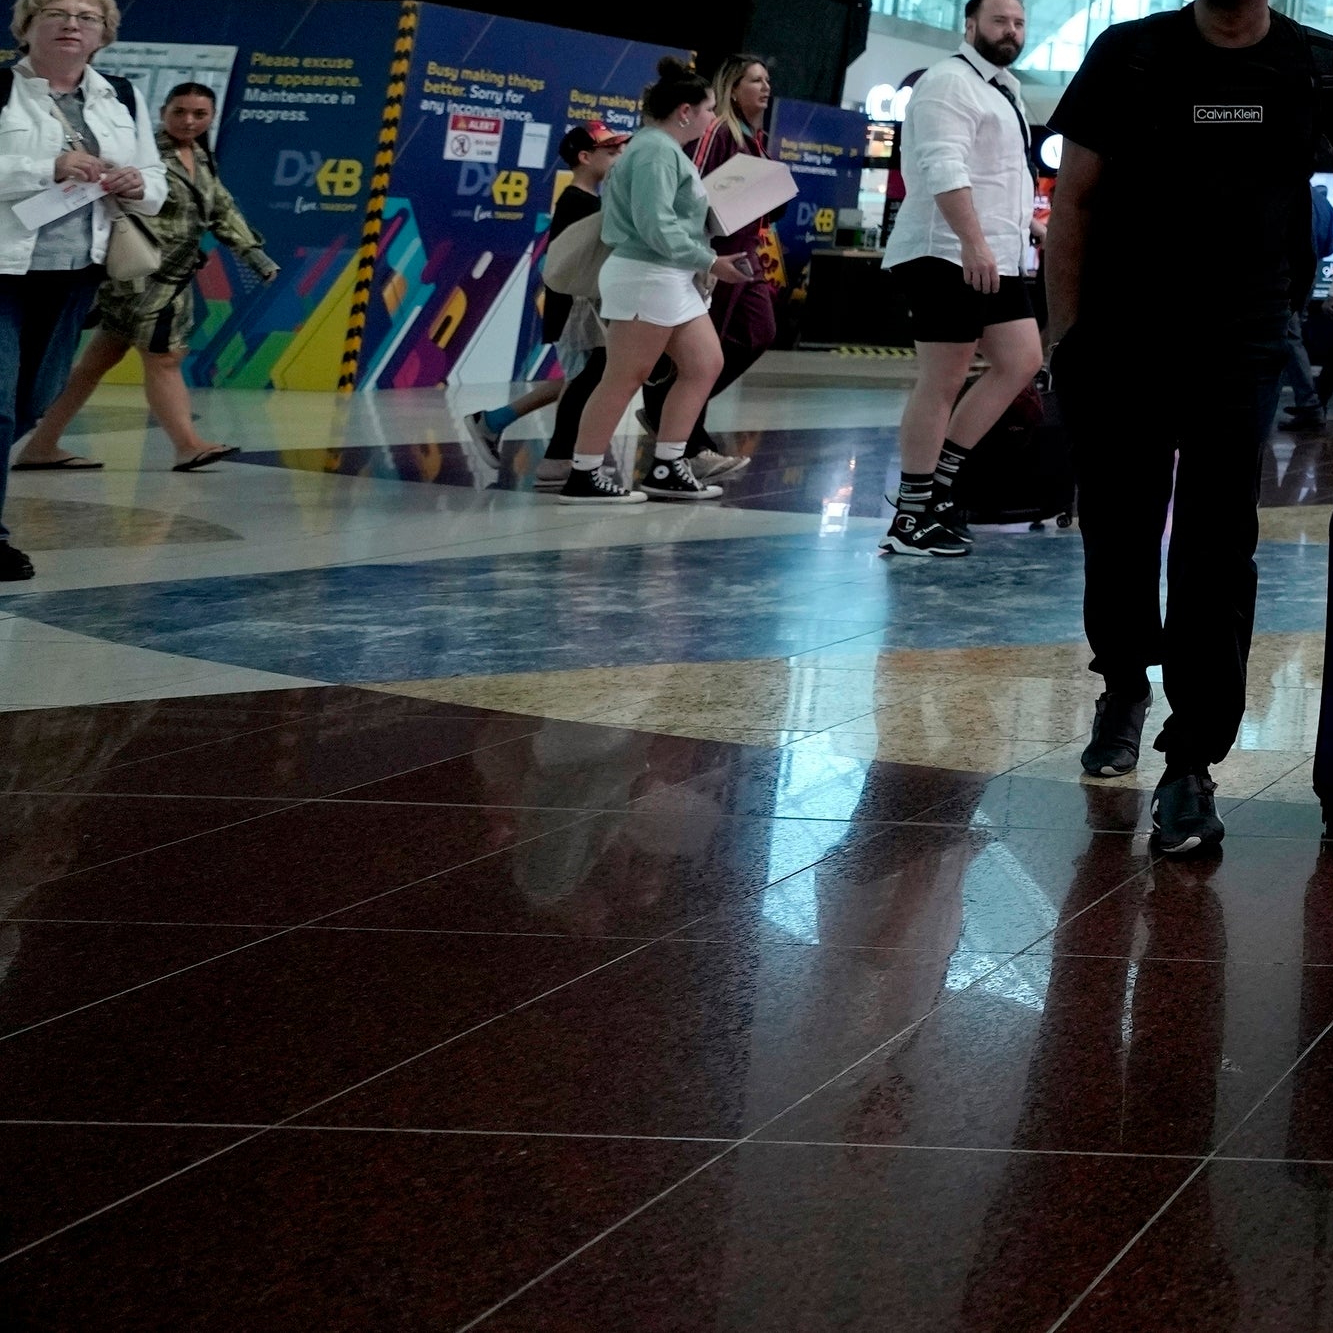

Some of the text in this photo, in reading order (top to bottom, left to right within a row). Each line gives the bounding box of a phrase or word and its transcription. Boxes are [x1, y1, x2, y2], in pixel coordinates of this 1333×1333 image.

[251, 52, 354, 69] Please excuse
[247, 74, 362, 88] our appearance.
[427, 61, 545, 93] Busy making things
[243, 88, 356, 105] Maintenance in
[470, 84, 502, 104] Sorry
[505, 89, 524, 104] for
[570, 89, 597, 107] Busy
[598, 95, 636, 113] making
[239, 108, 309, 123] progress.
[420, 99, 444, 115] any
[1196, 108, 1260, 120] Calvin Klein
[468, 120, 496, 131] ALERT
[606, 110, 634, 128] Sorry
